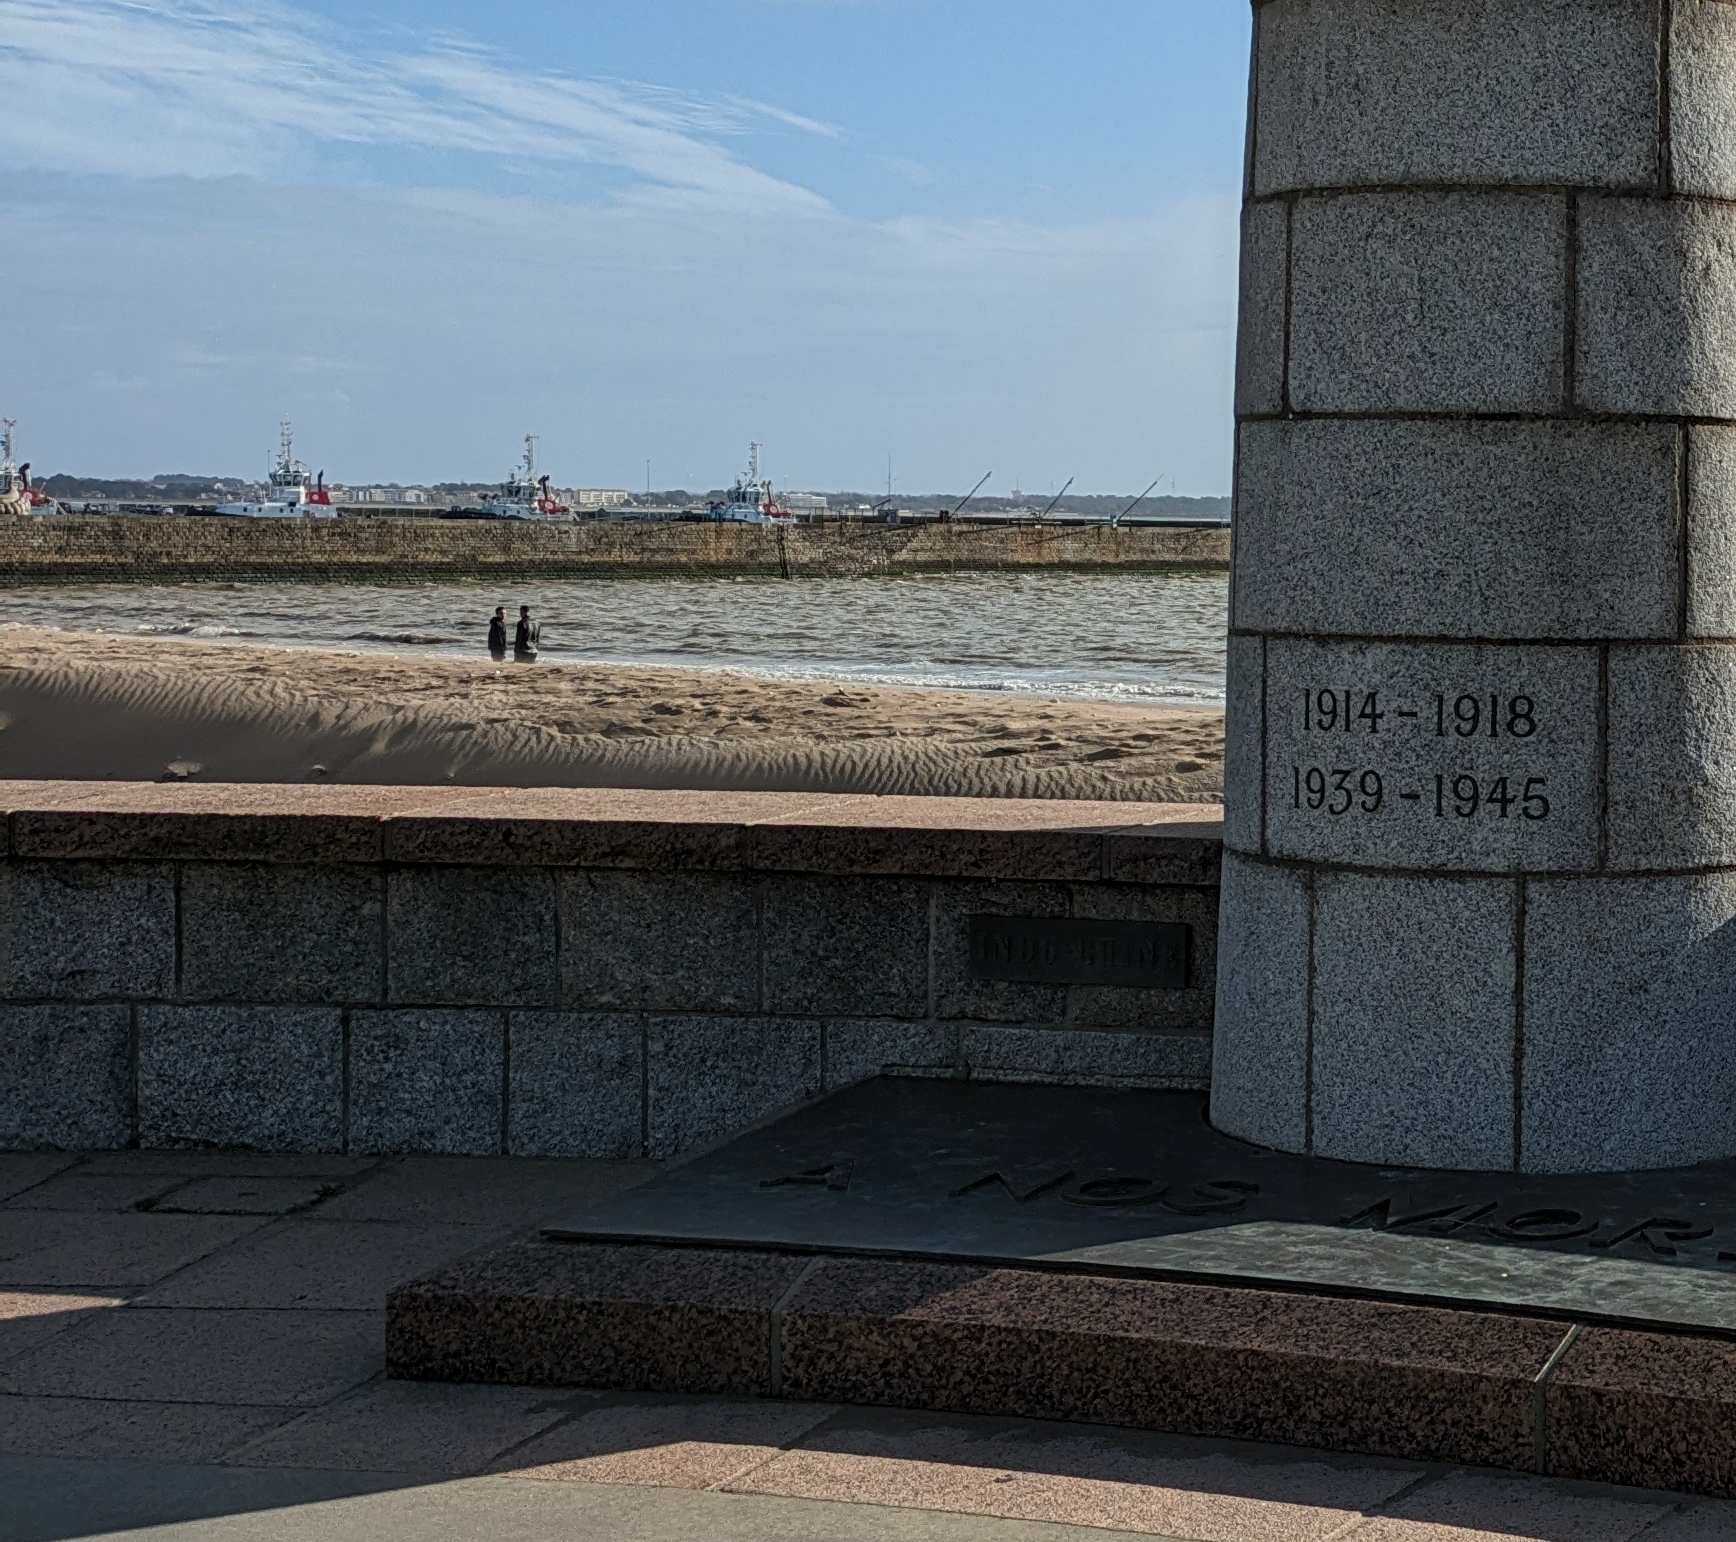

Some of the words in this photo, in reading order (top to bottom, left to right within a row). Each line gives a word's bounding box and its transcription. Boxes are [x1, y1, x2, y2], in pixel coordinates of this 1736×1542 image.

[1303, 688, 1384, 734] 1914
[1435, 694, 1538, 738] 1918
[1293, 766, 1383, 815] 1939
[1434, 774, 1551, 820] 1945
[758, 1158, 856, 1193] A
[947, 1170, 1260, 1217] NOS
